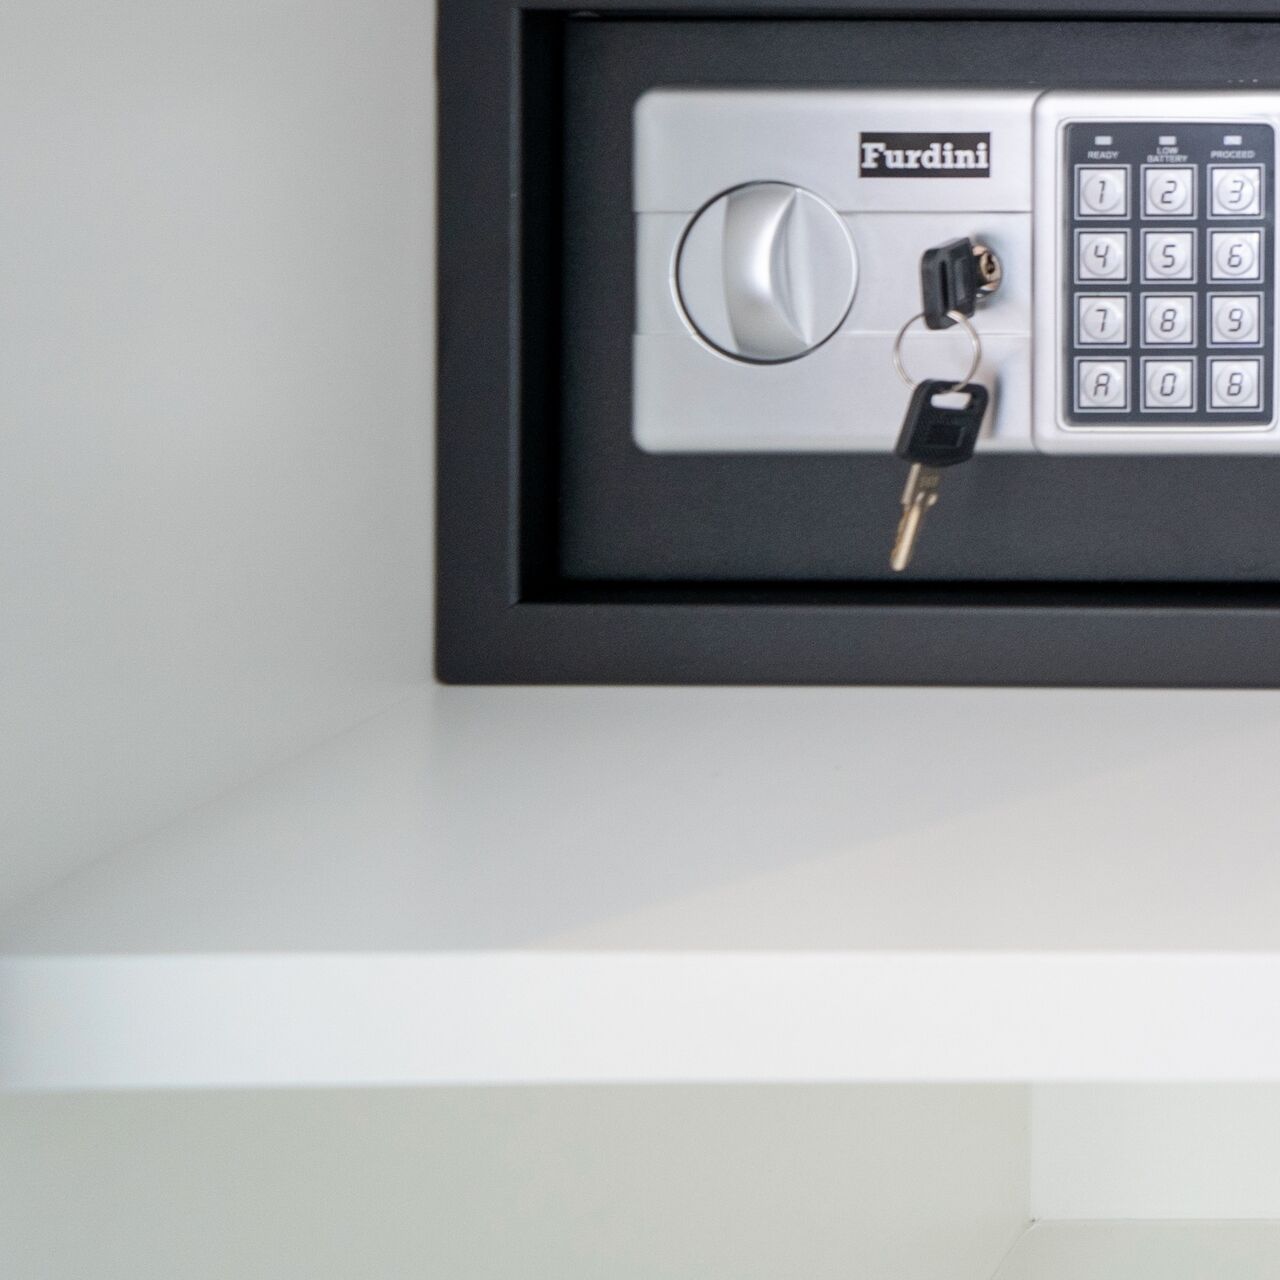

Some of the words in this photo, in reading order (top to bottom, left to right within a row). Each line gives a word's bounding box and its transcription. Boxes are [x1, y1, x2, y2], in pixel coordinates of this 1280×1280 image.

[861, 142, 989, 169] Furdini
[1087, 150, 1119, 160] READY
[1147, 155, 1188, 163] BATTERY
[1156, 147, 1178, 155] LOW
[1210, 150, 1256, 159] PROCEED
[1161, 181, 1177, 204] 2
[1228, 181, 1244, 204] 3
[1094, 245, 1109, 268] 4
[1161, 245, 1176, 268] 5
[1227, 245, 1242, 268] 6
[1095, 309, 1108, 332] 7
[1160, 309, 1176, 332] 8
[1228, 309, 1244, 332] 9
[1094, 373, 1110, 396] A
[1160, 373, 1176, 396] 0
